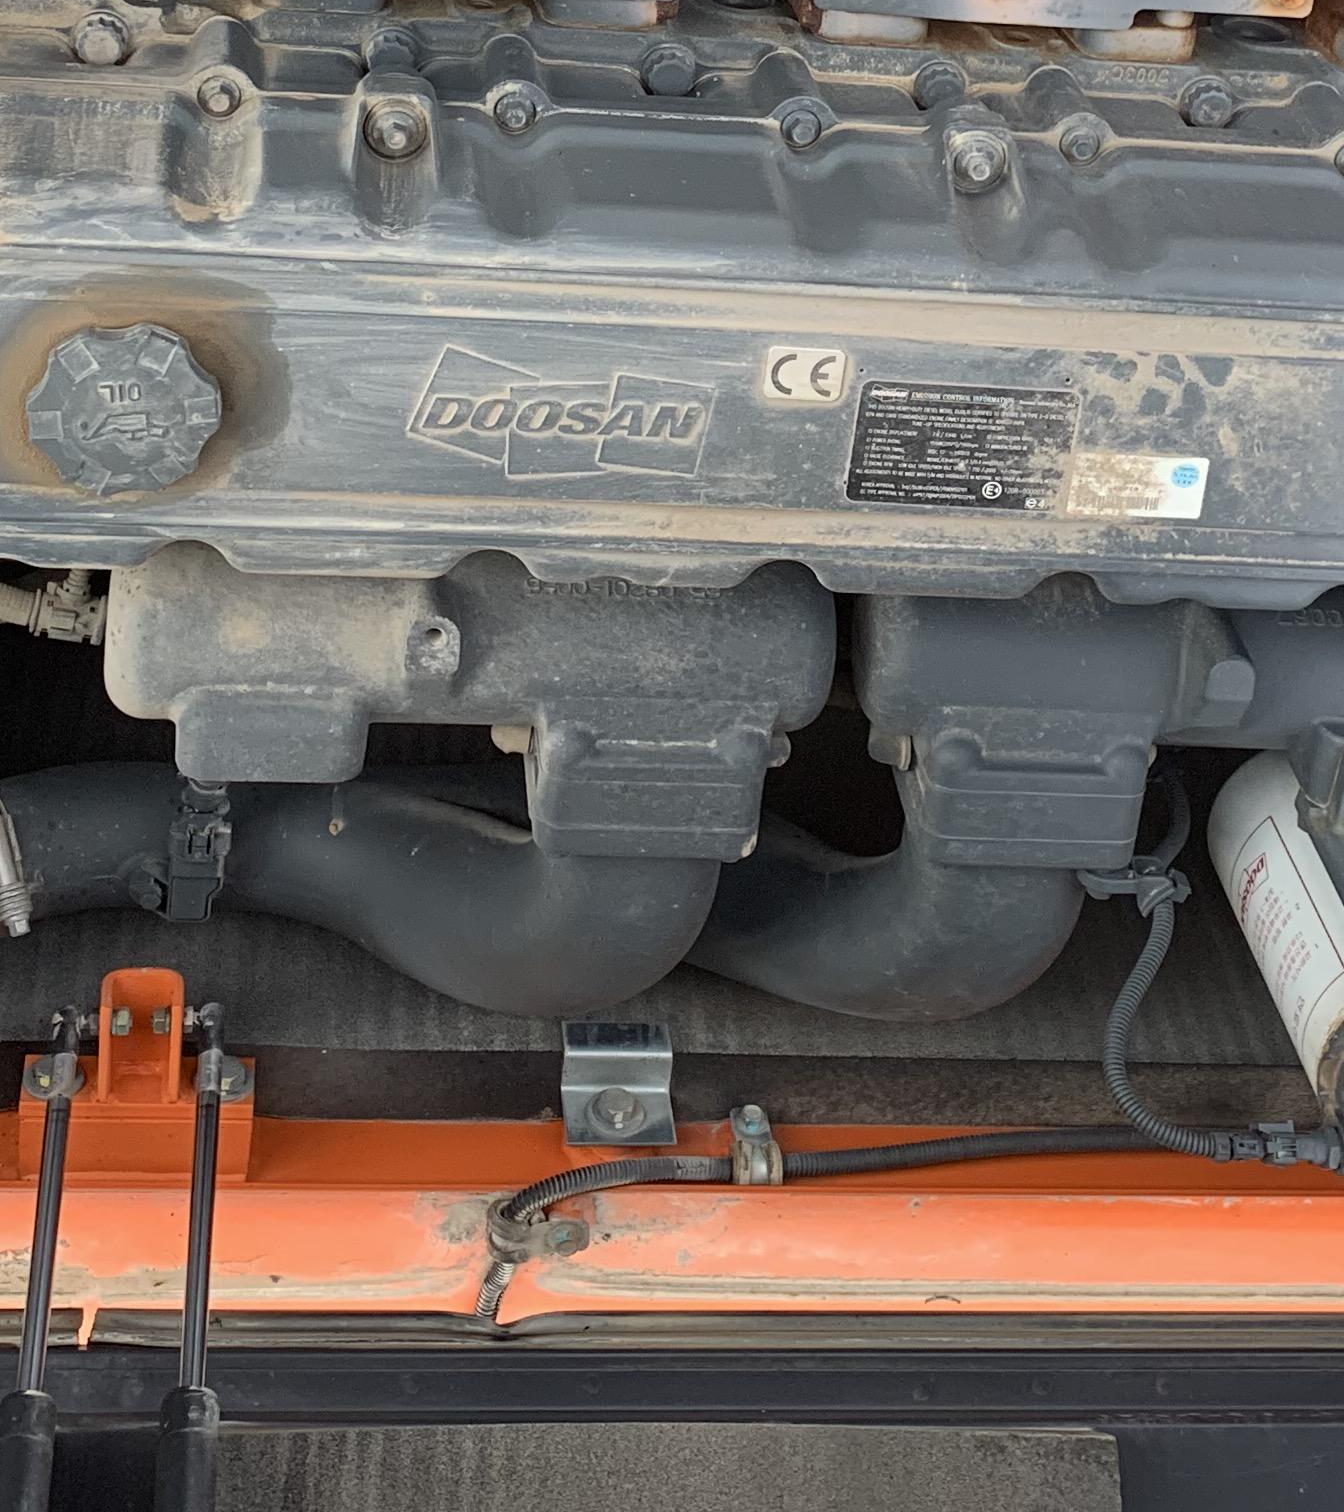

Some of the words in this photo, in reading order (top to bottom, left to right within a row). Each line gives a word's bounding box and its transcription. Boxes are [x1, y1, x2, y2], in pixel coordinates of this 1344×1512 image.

[98, 382, 142, 403] OIL
[771, 353, 837, 397] CE
[421, 394, 704, 441] DOOSAN
